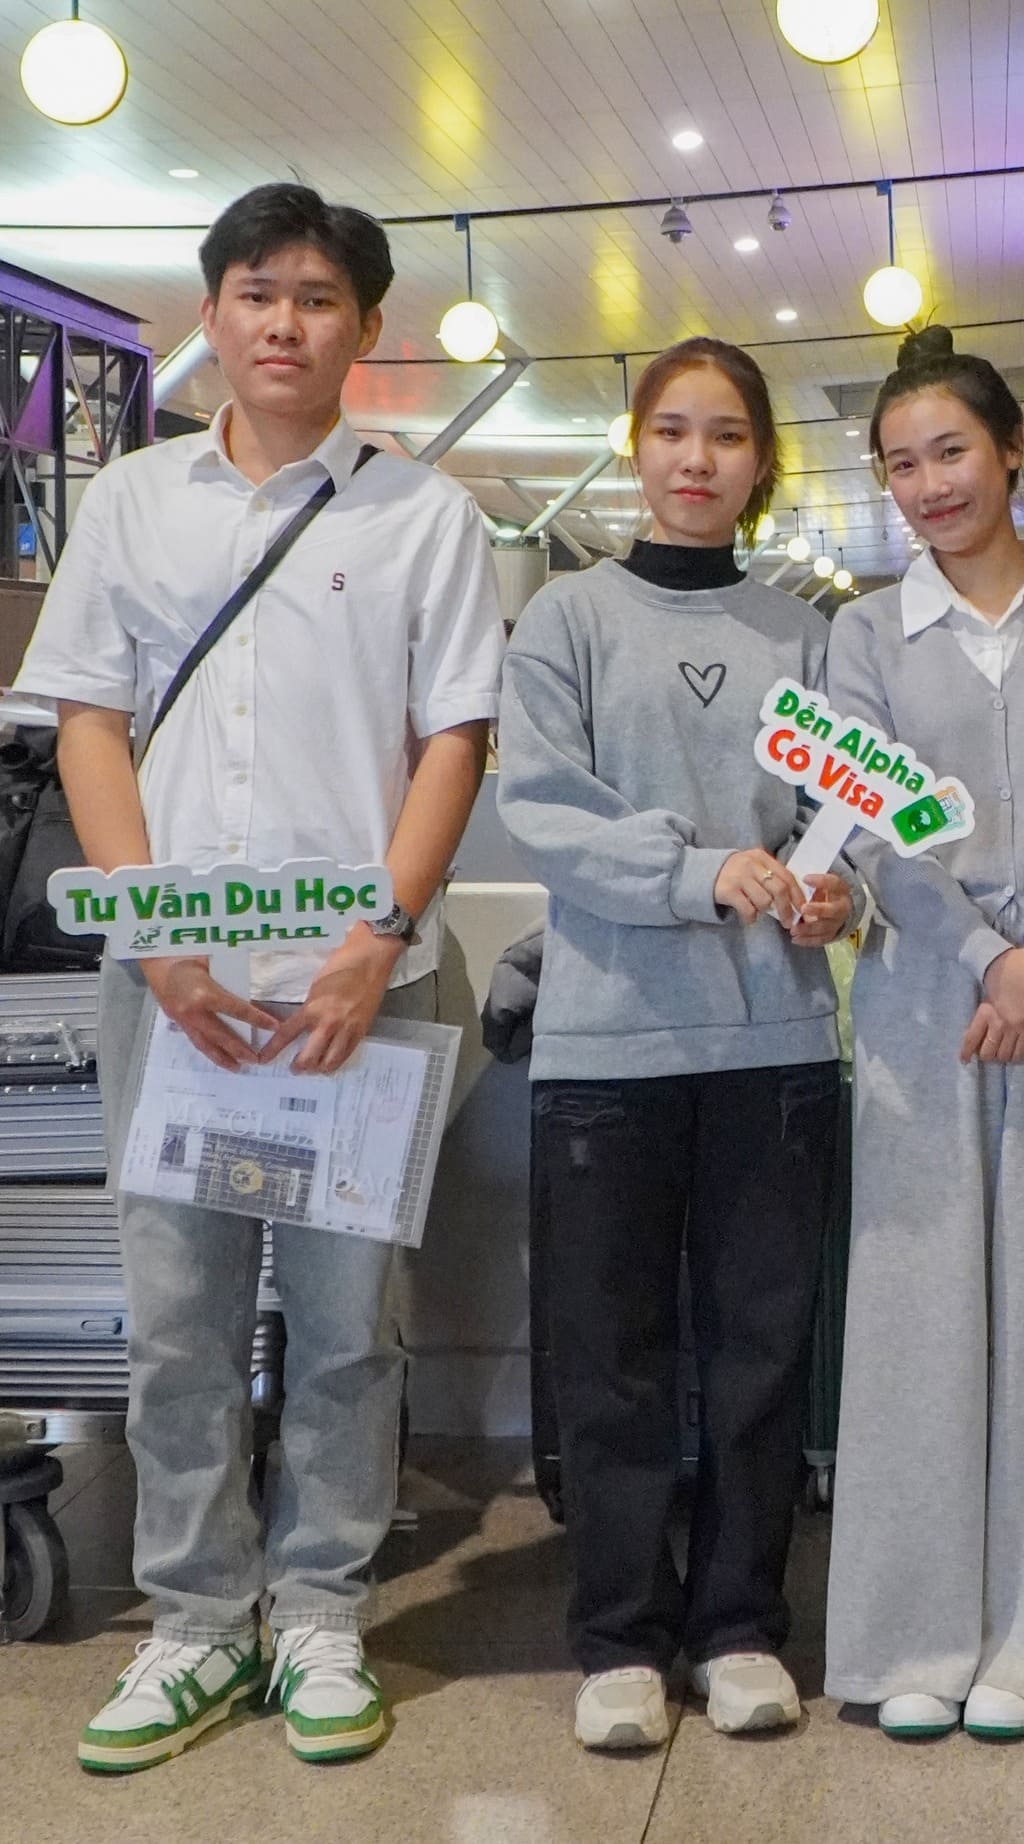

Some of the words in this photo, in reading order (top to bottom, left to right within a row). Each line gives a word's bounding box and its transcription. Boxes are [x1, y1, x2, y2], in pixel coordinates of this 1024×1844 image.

[331, 572, 345, 591] S
[774, 688, 833, 741] Đến
[834, 727, 925, 795] Alpha
[767, 729, 811, 773] Có
[818, 754, 884, 819] Visa
[66, 889, 118, 923] Tư
[127, 883, 211, 920] Vấn
[225, 881, 281, 915] Du
[295, 878, 376, 915] Học
[170, 923, 329, 947] Alpha
